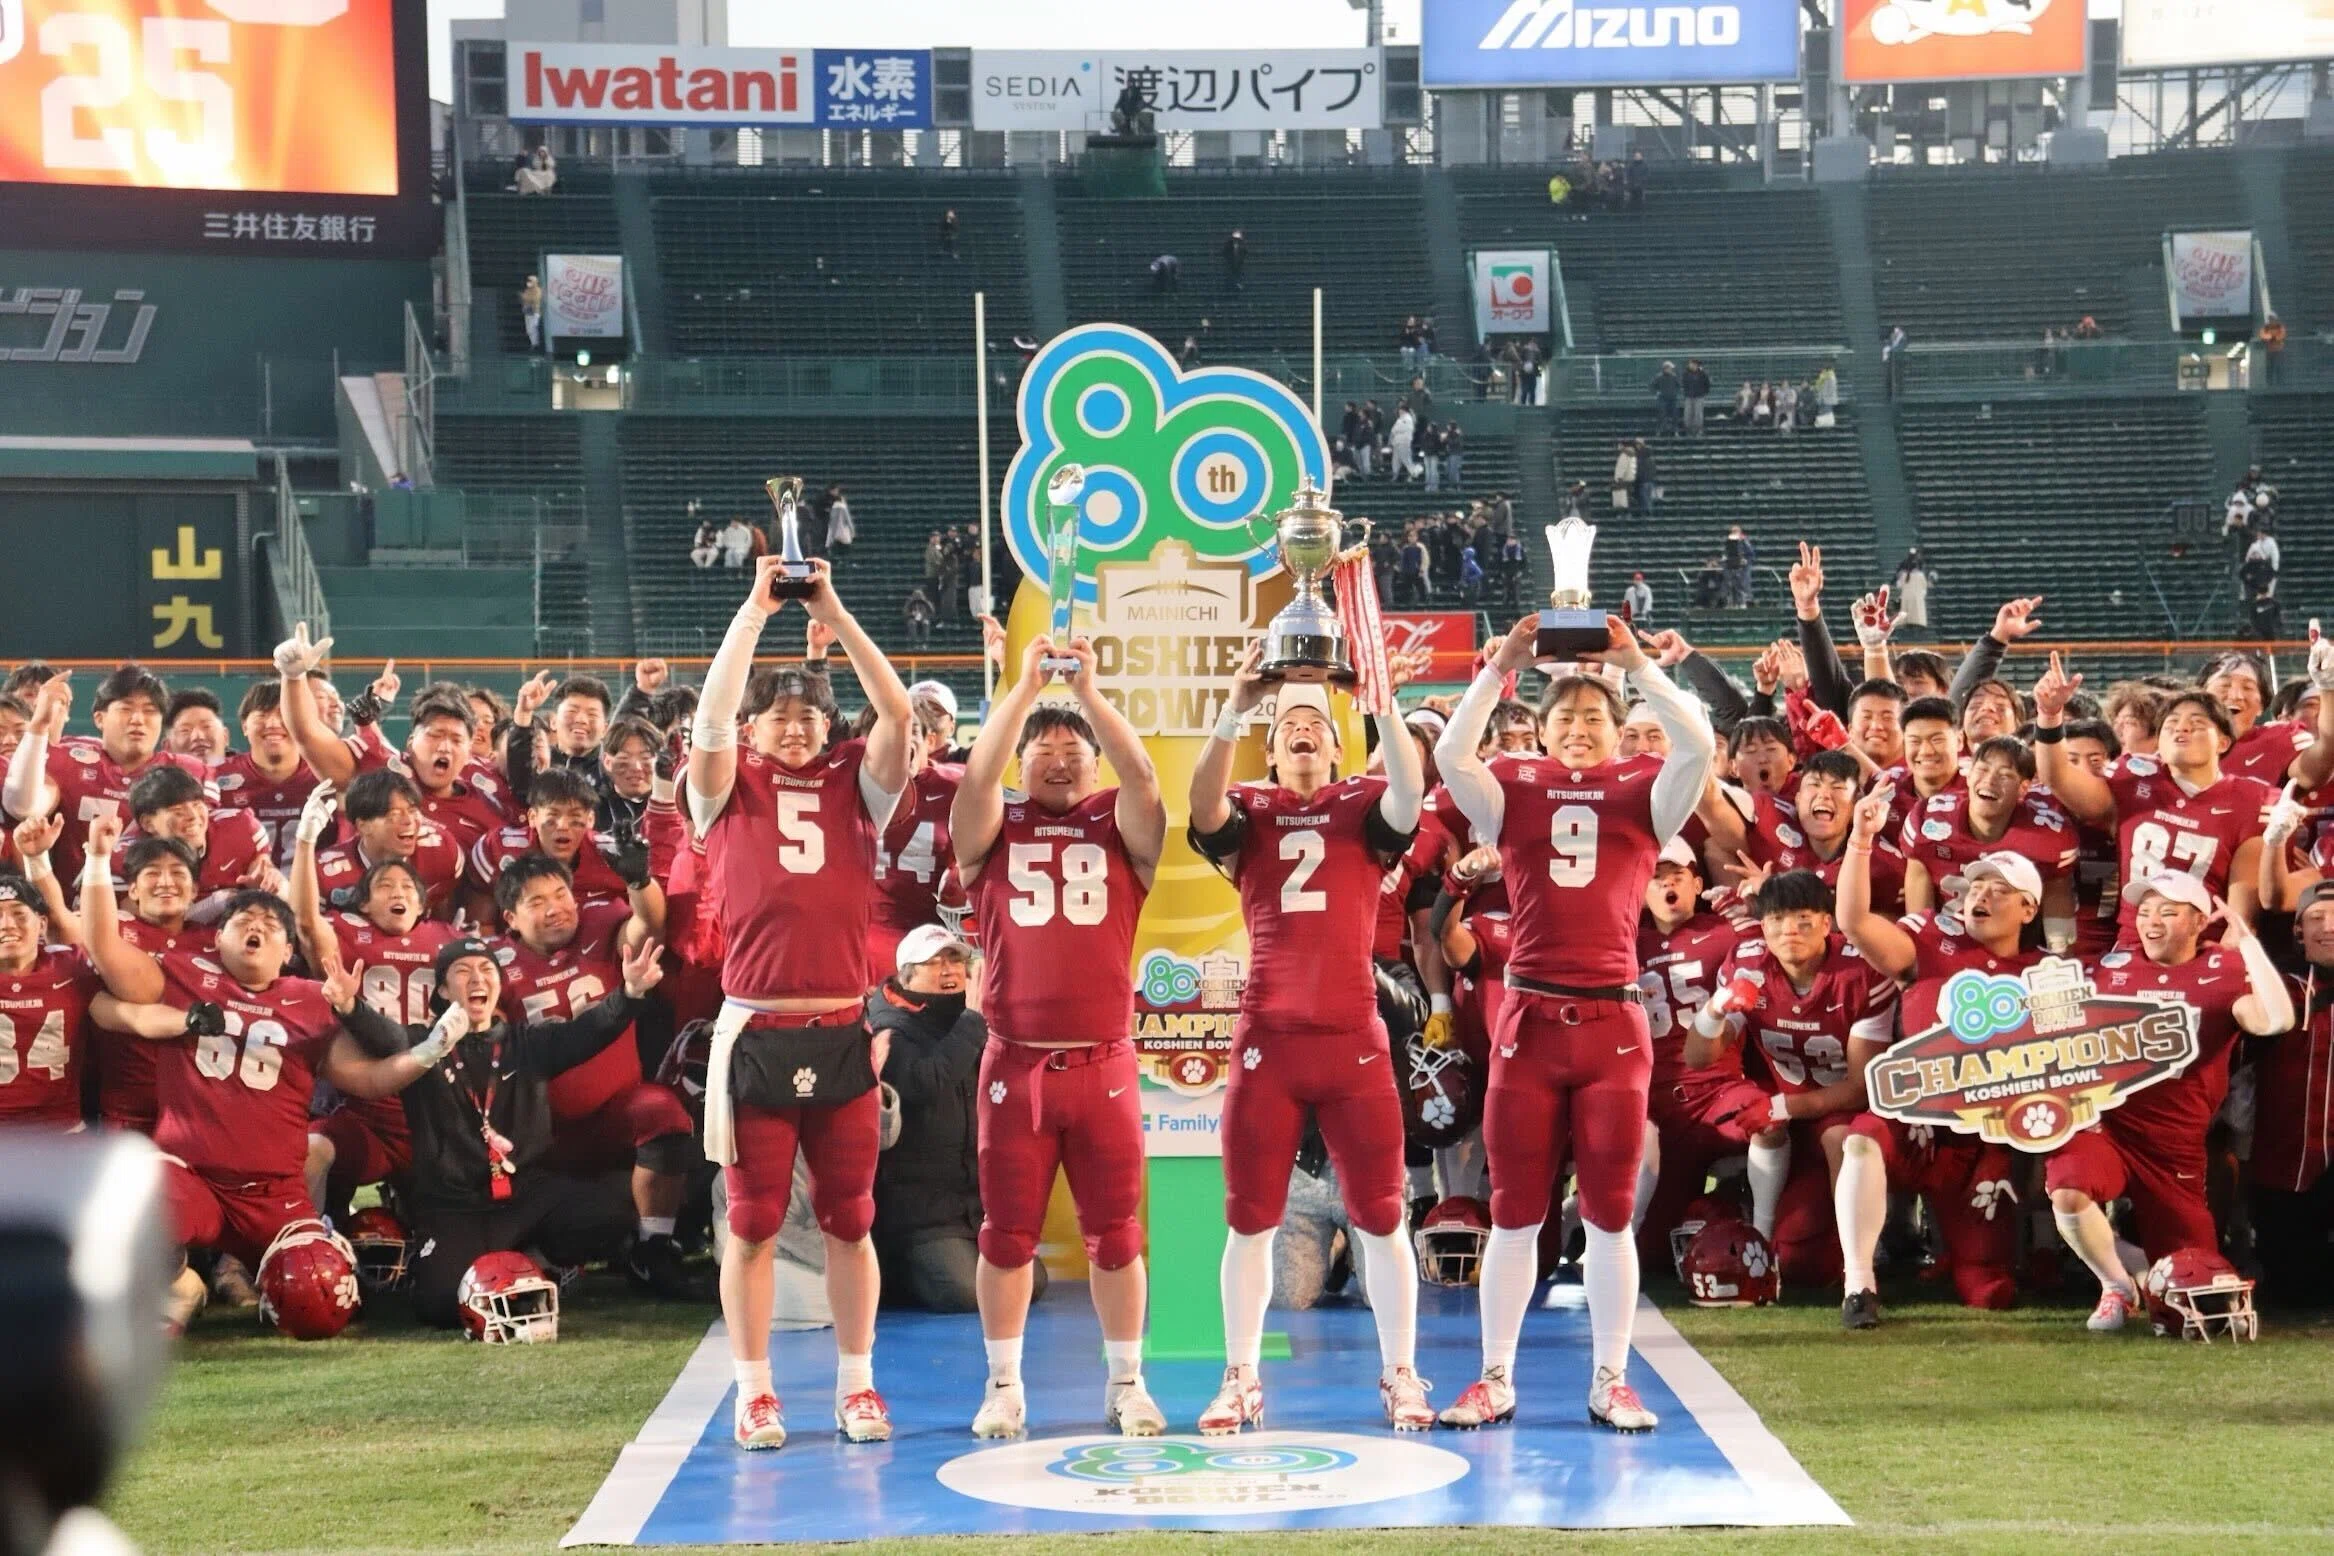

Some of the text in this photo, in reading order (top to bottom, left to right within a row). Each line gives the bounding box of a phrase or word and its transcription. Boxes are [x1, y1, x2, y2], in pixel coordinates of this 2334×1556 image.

[524, 51, 798, 112] Iwatani
[827, 56, 916, 102] 水素
[985, 76, 1081, 98] SEDIA
[828, 103, 918, 123] エネルギー
[1012, 102, 1057, 111] SYSTEM
[203, 212, 377, 243] 三井住友銀行
[1207, 463, 1236, 493] th
[151, 524, 224, 649] 山九
[1127, 606, 1218, 621] MAINICHI
[1082, 635, 1257, 677] OSHIE
[772, 773, 824, 788] RITSUMEIKAN
[1546, 789, 1604, 801] RITSUMEIKAN
[776, 790, 825, 874] 5
[1034, 826, 1084, 838] RITSUMEIKAN
[1276, 814, 1330, 827] RITSUMEIKAN
[1549, 805, 1598, 888] 9
[2130, 821, 2219, 884] 87
[1278, 829, 1326, 913] 2
[1007, 842, 1108, 927] 58
[383, 950, 430, 963] RITSUMEIKAN
[535, 967, 579, 988] RITSUMEIKAN
[0, 999, 44, 1009] TSUMEIKAN
[227, 999, 274, 1017] RITSUMEIKAN
[1776, 1018, 1821, 1031] RITSUMEIKAN
[195, 1010, 288, 1091] 66
[1143, 1040, 1233, 1050] KOSHIEN BOW
[1875, 1012, 2191, 1109] CHAMPIONS
[1964, 1068, 2103, 1104] KOSHIEN BOWL
[1158, 1113, 1223, 1134] Family
[1691, 1271, 1718, 1299] 53
